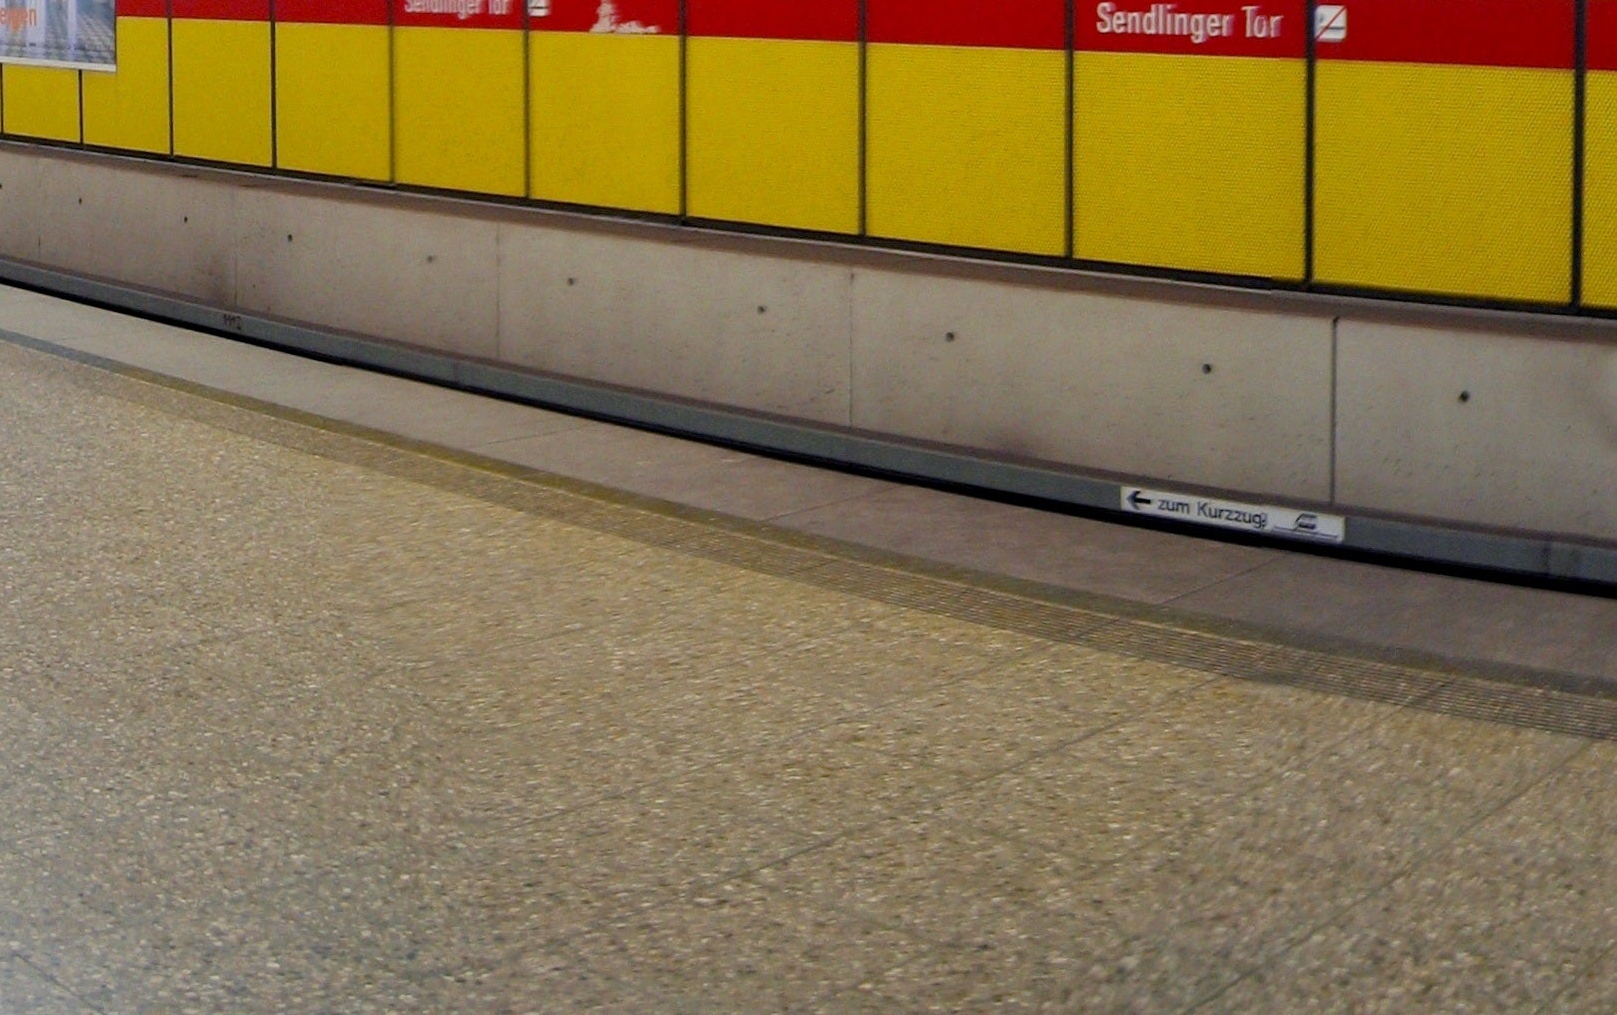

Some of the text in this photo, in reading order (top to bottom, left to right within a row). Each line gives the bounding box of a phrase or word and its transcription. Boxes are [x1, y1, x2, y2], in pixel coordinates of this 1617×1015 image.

[1096, 2, 1284, 44] Sendlinger Tor
[1158, 499, 1266, 530] zum Kurzzug
